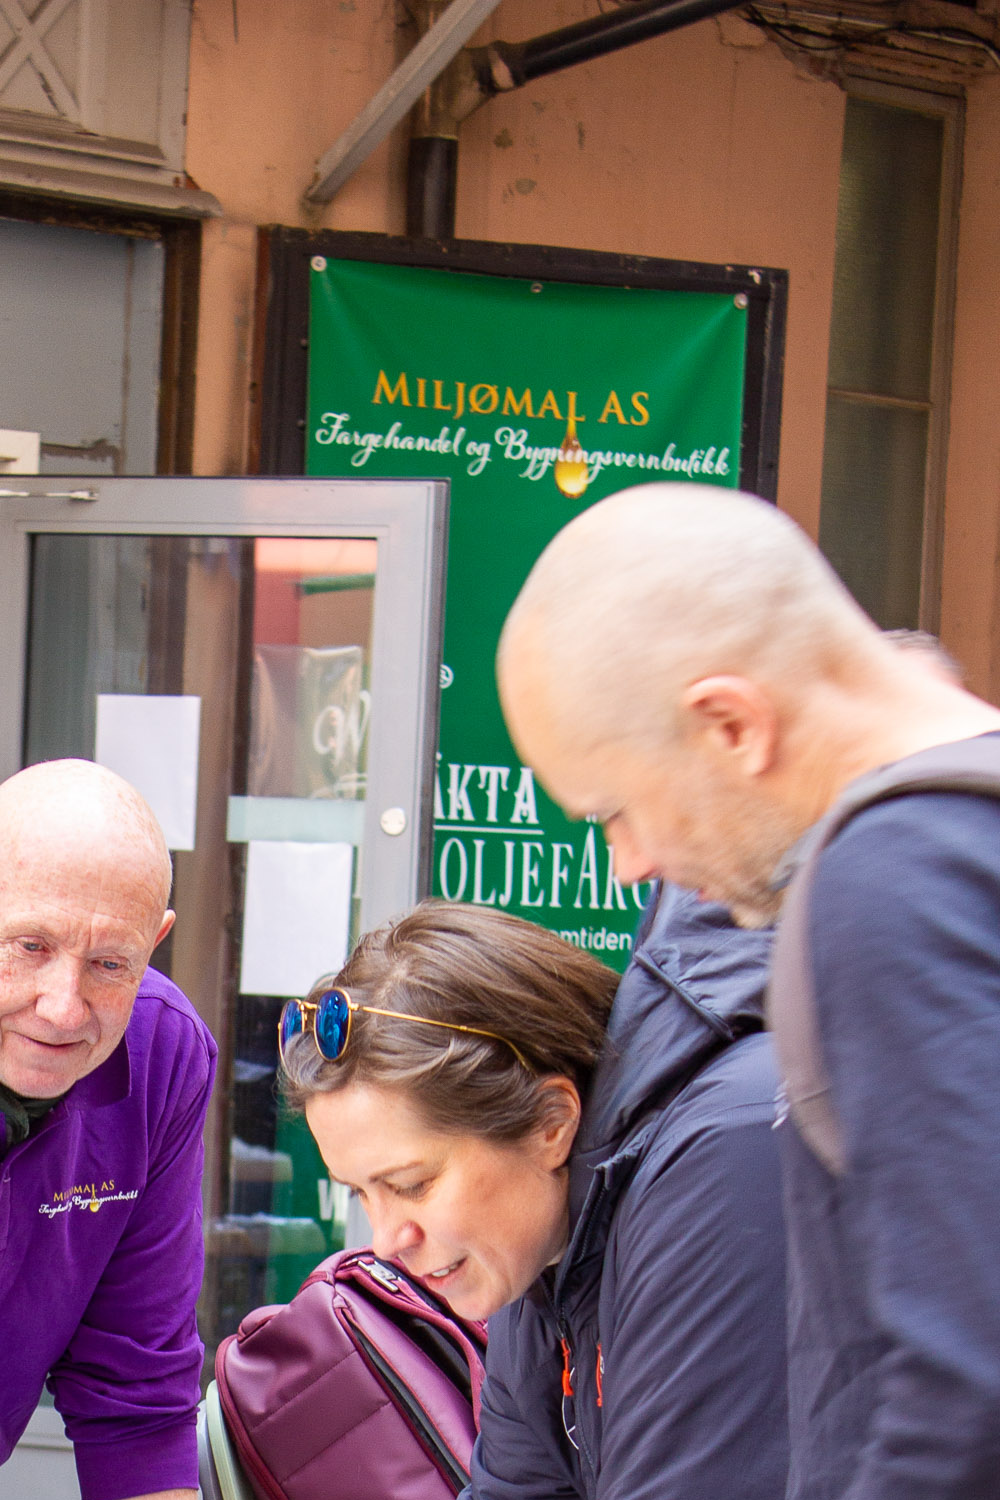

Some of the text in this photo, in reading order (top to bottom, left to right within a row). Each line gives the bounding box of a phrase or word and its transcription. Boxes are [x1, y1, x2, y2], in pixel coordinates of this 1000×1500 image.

[371, 369, 650, 426] MILJØMAL AS
[315, 412, 730, 484] Fargehandel og Bygningsvernbutikk
[100, 1179, 115, 1192] AS
